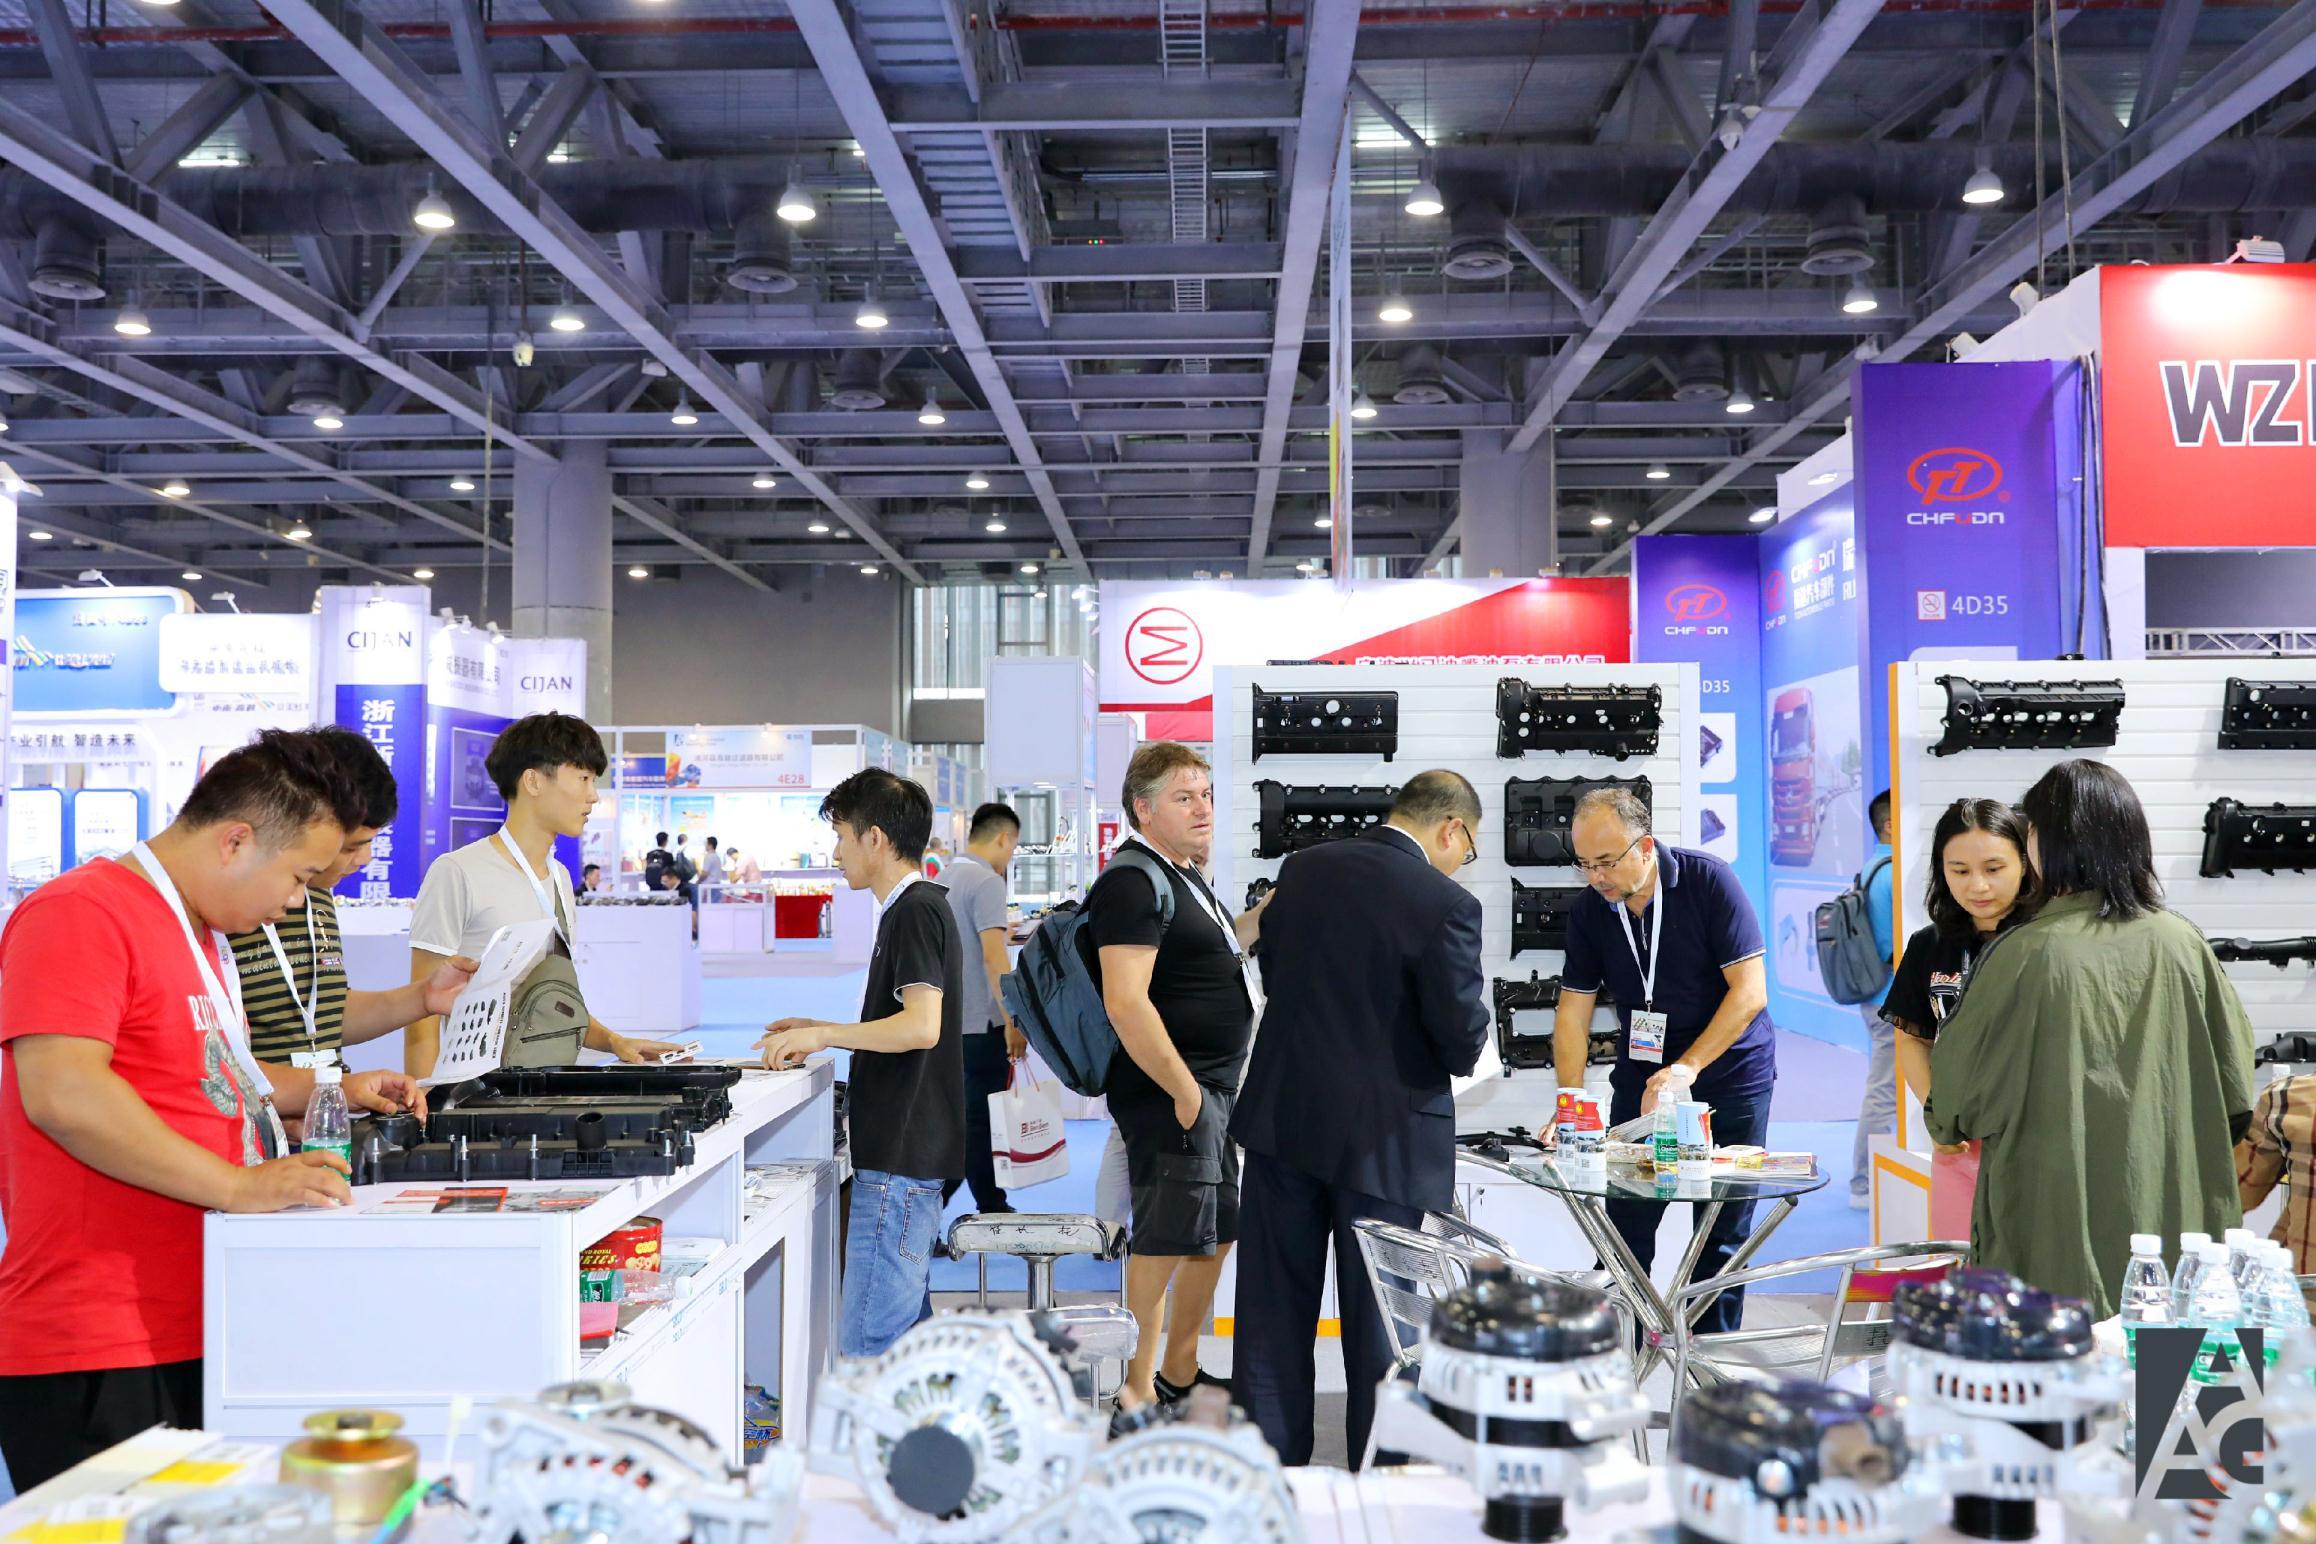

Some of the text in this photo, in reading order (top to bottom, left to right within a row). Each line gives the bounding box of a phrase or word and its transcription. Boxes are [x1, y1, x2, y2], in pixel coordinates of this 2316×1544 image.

[2159, 359, 2316, 447] WZ
[1951, 595, 2009, 615] 4D35
[520, 676, 573, 693] CIJAN
[1699, 680, 1730, 694] D35
[777, 774, 805, 784] 4E28
